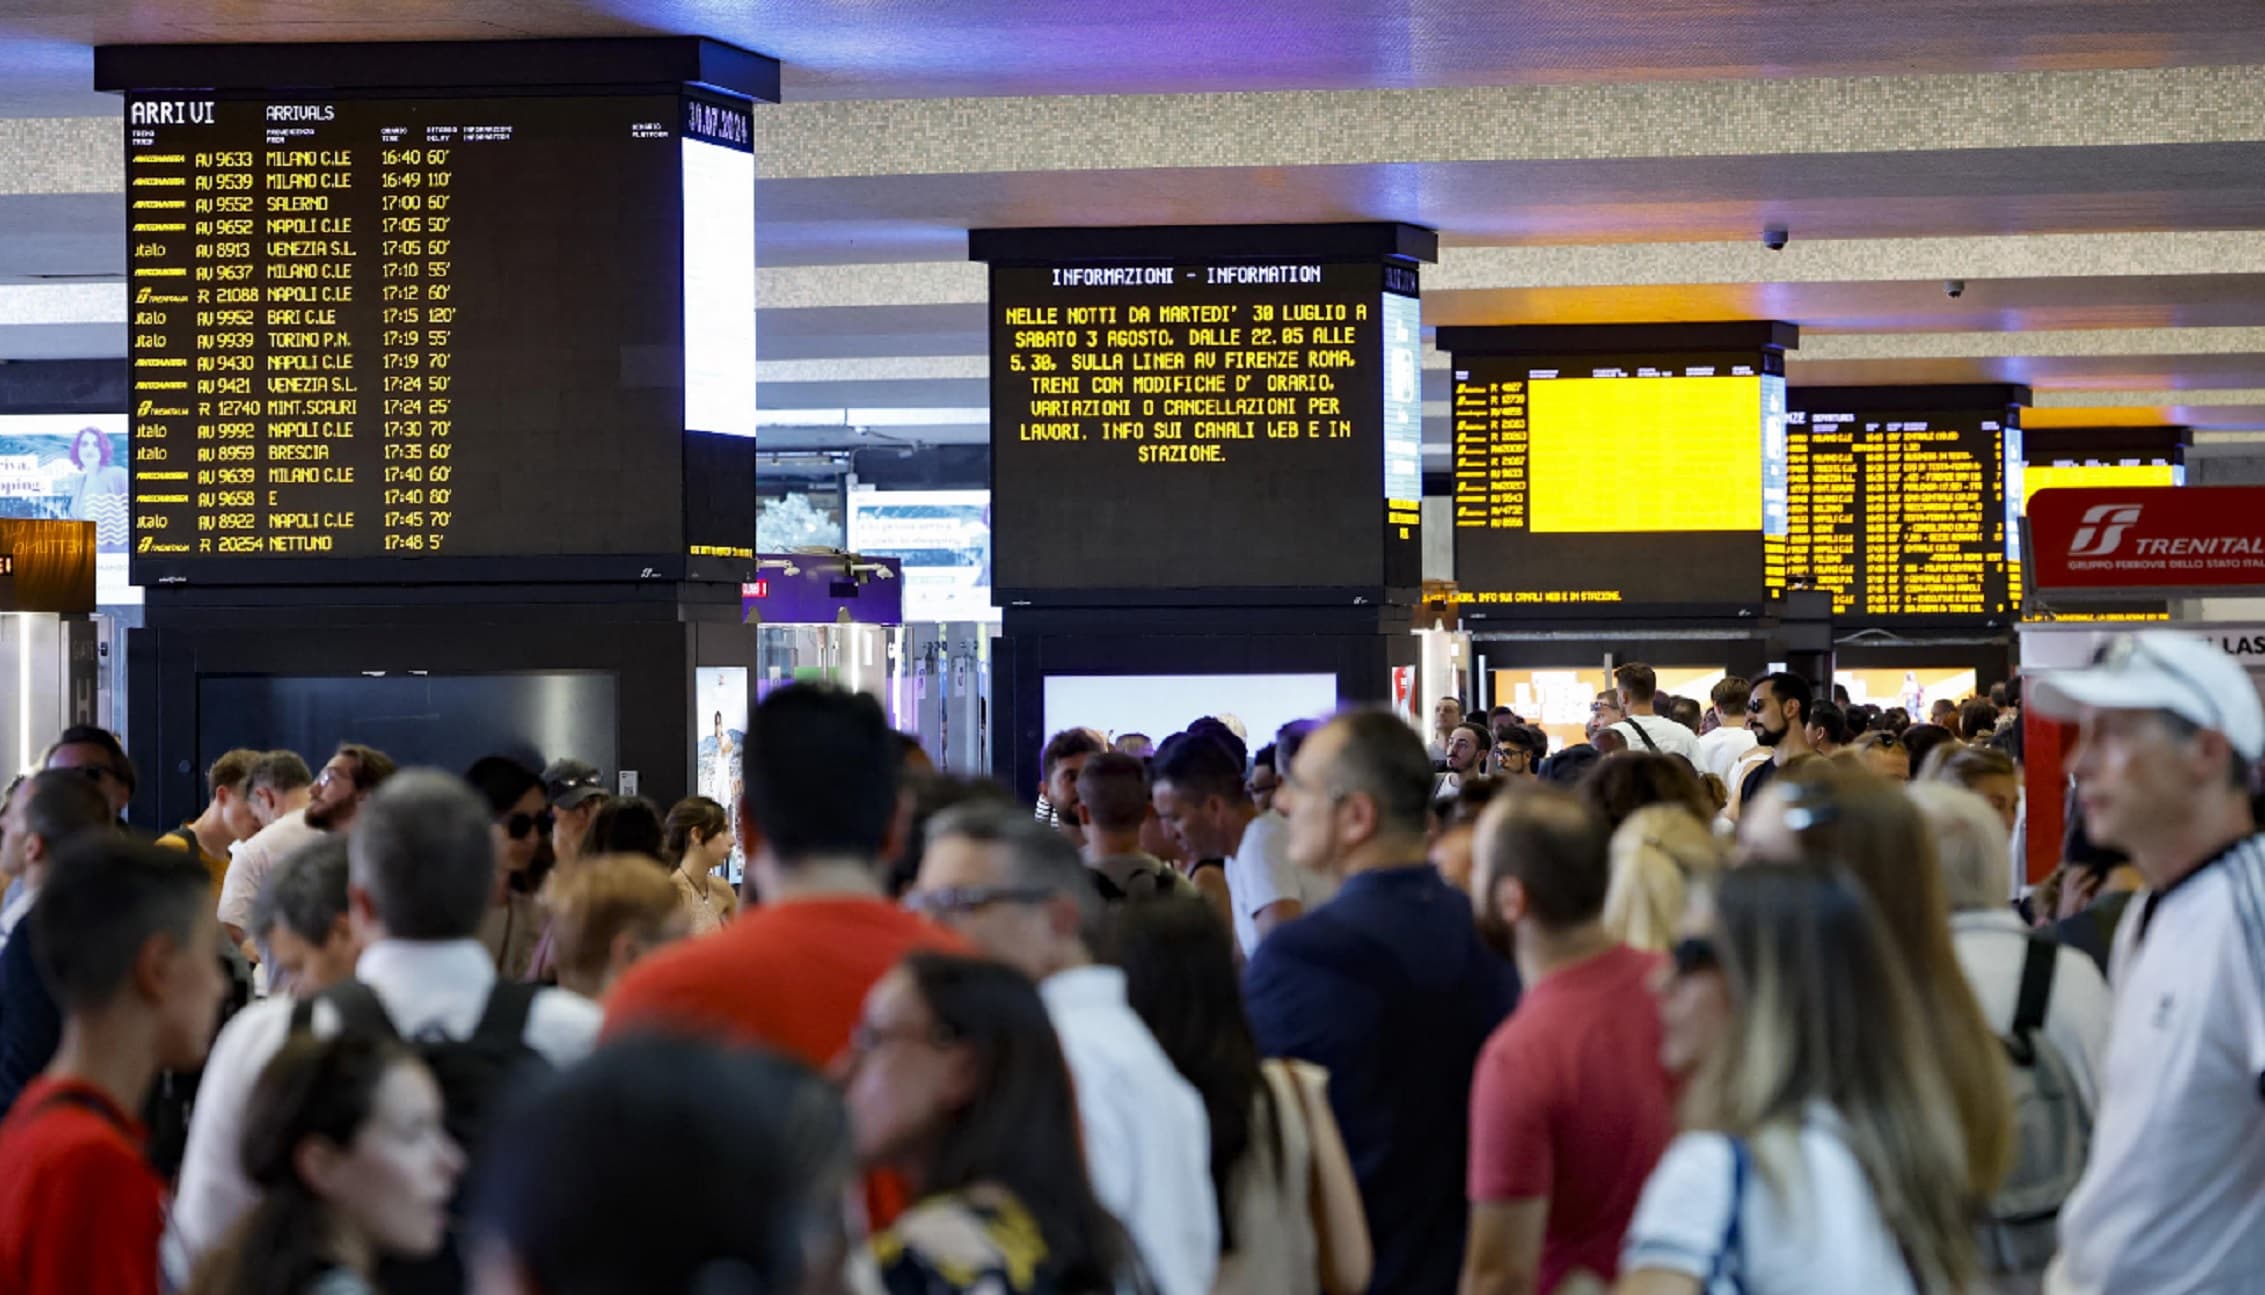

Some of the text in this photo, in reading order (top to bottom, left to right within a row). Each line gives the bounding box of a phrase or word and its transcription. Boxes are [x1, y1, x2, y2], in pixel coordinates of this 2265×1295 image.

[131, 101, 215, 125] ARRIVI
[266, 105, 335, 121] ARRIVALS
[195, 152, 213, 168] AV
[215, 151, 253, 167] 9633
[266, 151, 317, 167] MILANO
[381, 149, 421, 165] 16:40
[195, 175, 213, 191] AV
[215, 173, 254, 190] 9539
[266, 172, 318, 190] MILANO
[381, 172, 421, 188] 16:49
[195, 198, 213, 214] AV
[216, 196, 254, 212] 9552
[266, 195, 329, 212] SALERNO
[382, 194, 421, 211] 17:00
[195, 221, 214, 236] AV
[216, 219, 254, 235] 9652
[266, 217, 317, 234] NAPOLI
[382, 216, 421, 233] 17:05
[195, 243, 214, 259] AV
[216, 242, 251, 258] 8913
[266, 240, 328, 257] VENEZIA
[382, 239, 422, 256] 17:05
[195, 266, 214, 282] AV
[216, 264, 254, 281] 9637
[266, 263, 319, 279] MILANO
[382, 261, 419, 278] 17:10
[1052, 265, 1321, 286] INFORMAZIONI INFORMATION
[196, 288, 210, 304] R
[216, 286, 260, 304] 21088
[266, 286, 317, 302] NAPOLI
[382, 284, 419, 301] 17:12
[196, 310, 215, 327] AV
[215, 309, 254, 326] 9952
[267, 309, 301, 326] BARI
[382, 307, 419, 324] 17:15
[1006, 307, 1058, 325] NELLE
[1067, 306, 1117, 325] NOTTI
[1128, 305, 1151, 324] DA
[1252, 304, 1274, 322] 30
[1282, 304, 1347, 321] LUGLIO
[1355, 303, 1367, 321] A
[196, 333, 215, 350] AV
[215, 332, 255, 349] 9939
[267, 331, 320, 348] TORINO
[382, 330, 419, 346] 17:19
[1014, 330, 1078, 348] SABATO
[1085, 329, 1099, 348] 3
[1188, 328, 1241, 346] DALLE
[1312, 326, 1356, 344] ALLE
[196, 356, 215, 372] AV
[215, 355, 255, 371] 9430
[267, 354, 318, 371] NAPOLI
[382, 352, 419, 369] 17:19
[1071, 352, 1124, 371] SULLA
[1132, 351, 1186, 371] LINEA
[1194, 351, 1216, 369] AV
[1224, 350, 1299, 369] FIRENZE
[197, 378, 216, 395] AV
[216, 377, 251, 394] 9421
[267, 376, 328, 394] VENEZIA
[383, 375, 422, 392] 17:24
[1030, 376, 1080, 395] TRENI
[1091, 375, 1124, 394] CON
[1133, 374, 1226, 394] MODIFICHE
[198, 401, 211, 417] R
[217, 400, 261, 417] 12740
[383, 399, 422, 415] 17:24
[1030, 397, 1341, 417] VARIAZIONI O CANCELLAZIONI PER
[197, 423, 216, 440] AV
[216, 422, 255, 439] 9992
[267, 421, 319, 439] NAPOLI
[384, 420, 423, 438] 17:30
[1102, 421, 1144, 440] INFO
[1153, 421, 1182, 440] SUI
[1194, 421, 1255, 439] CANALI
[1267, 420, 1299, 439] WEB
[1308, 420, 1320, 438] E
[1329, 420, 1351, 438] IN
[197, 445, 216, 463] AV
[216, 444, 256, 462] 8959
[267, 444, 329, 461] BRESCIA
[384, 443, 423, 460] 17:35
[197, 468, 216, 485] AV
[216, 467, 256, 484] 9639
[268, 467, 320, 484] MILANO
[384, 465, 423, 483] 17:40
[197, 491, 216, 508] AV
[216, 490, 256, 507] 9658
[268, 490, 278, 507] E
[384, 488, 424, 505] 17:40
[197, 513, 216, 531] AV
[216, 512, 256, 530] 8922
[268, 512, 319, 529] NAPOLI
[384, 511, 424, 528] 17:45
[199, 538, 212, 553] R
[218, 535, 264, 553] 20254
[268, 534, 333, 552] NETTUNO
[384, 534, 424, 550] 17:48
[2067, 559, 2114, 570] GRUPPO
[2169, 558, 2204, 569] DELLO
[2206, 558, 2241, 569] STATO
